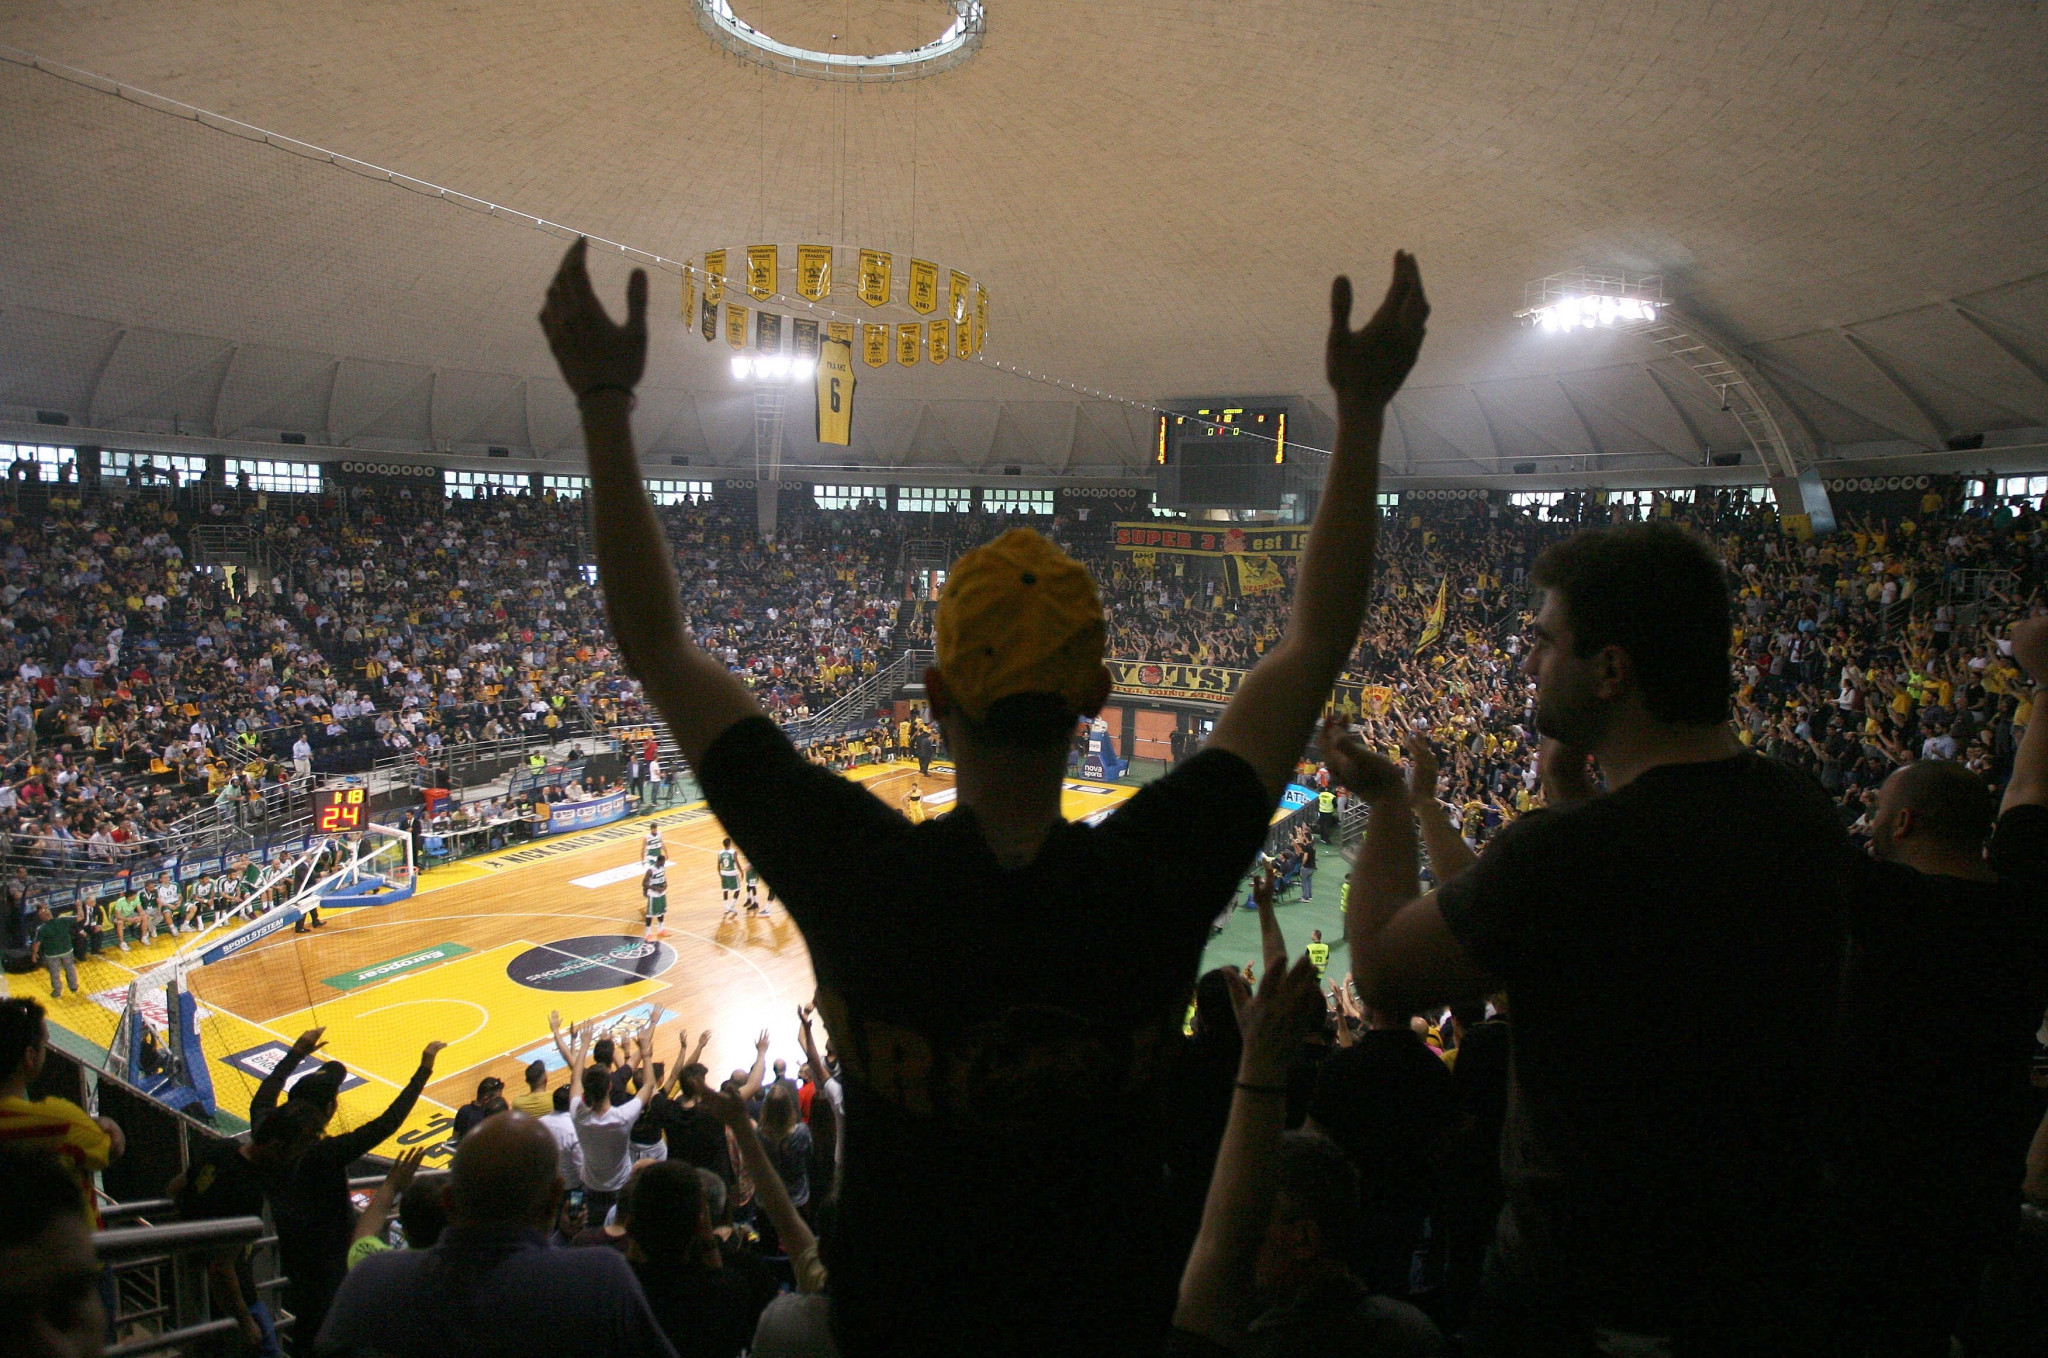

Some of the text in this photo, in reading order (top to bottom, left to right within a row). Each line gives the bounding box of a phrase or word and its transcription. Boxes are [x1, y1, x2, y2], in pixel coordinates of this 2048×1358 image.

[866, 293, 883, 302] 1986
[830, 377, 841, 413] 6
[1116, 529, 1191, 549] SUPER
[1201, 534, 1215, 550] 3
[1252, 535, 1282, 550] est
[1189, 692, 1232, 702] STRON
[1084, 764, 1102, 772] nova
[322, 806, 359, 829] 24
[501, 848, 552, 864] NICK
[550, 836, 605, 854] GALIS
[222, 917, 284, 954] SPORT SYSTEM
[357, 950, 445, 981] Europcar
